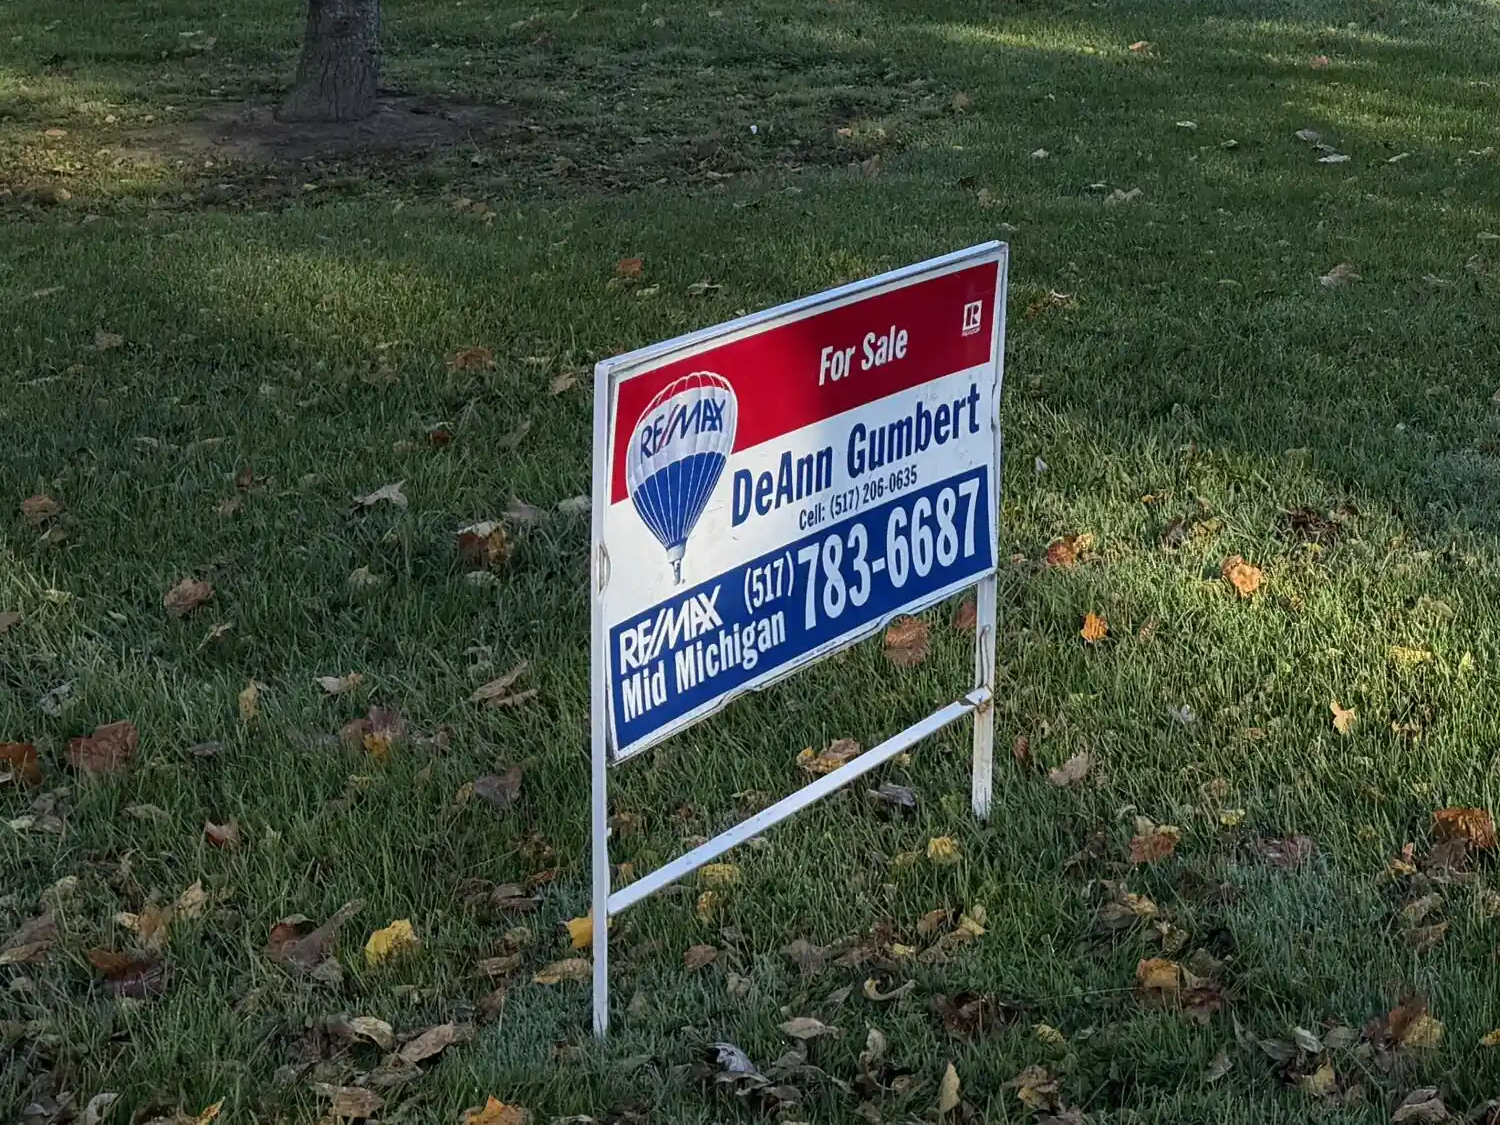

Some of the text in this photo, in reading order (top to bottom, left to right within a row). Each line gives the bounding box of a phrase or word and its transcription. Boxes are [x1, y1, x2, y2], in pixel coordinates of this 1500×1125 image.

[818, 324, 909, 387] For Sale
[640, 398, 726, 462] RE/MAX
[731, 382, 981, 529] DeAnn Gumbert
[799, 464, 918, 530] Cell: (517) 206-0635
[743, 476, 981, 631] (517) 783-6687
[620, 585, 723, 674] RE/MAX
[621, 610, 786, 724] Mid Michigan
